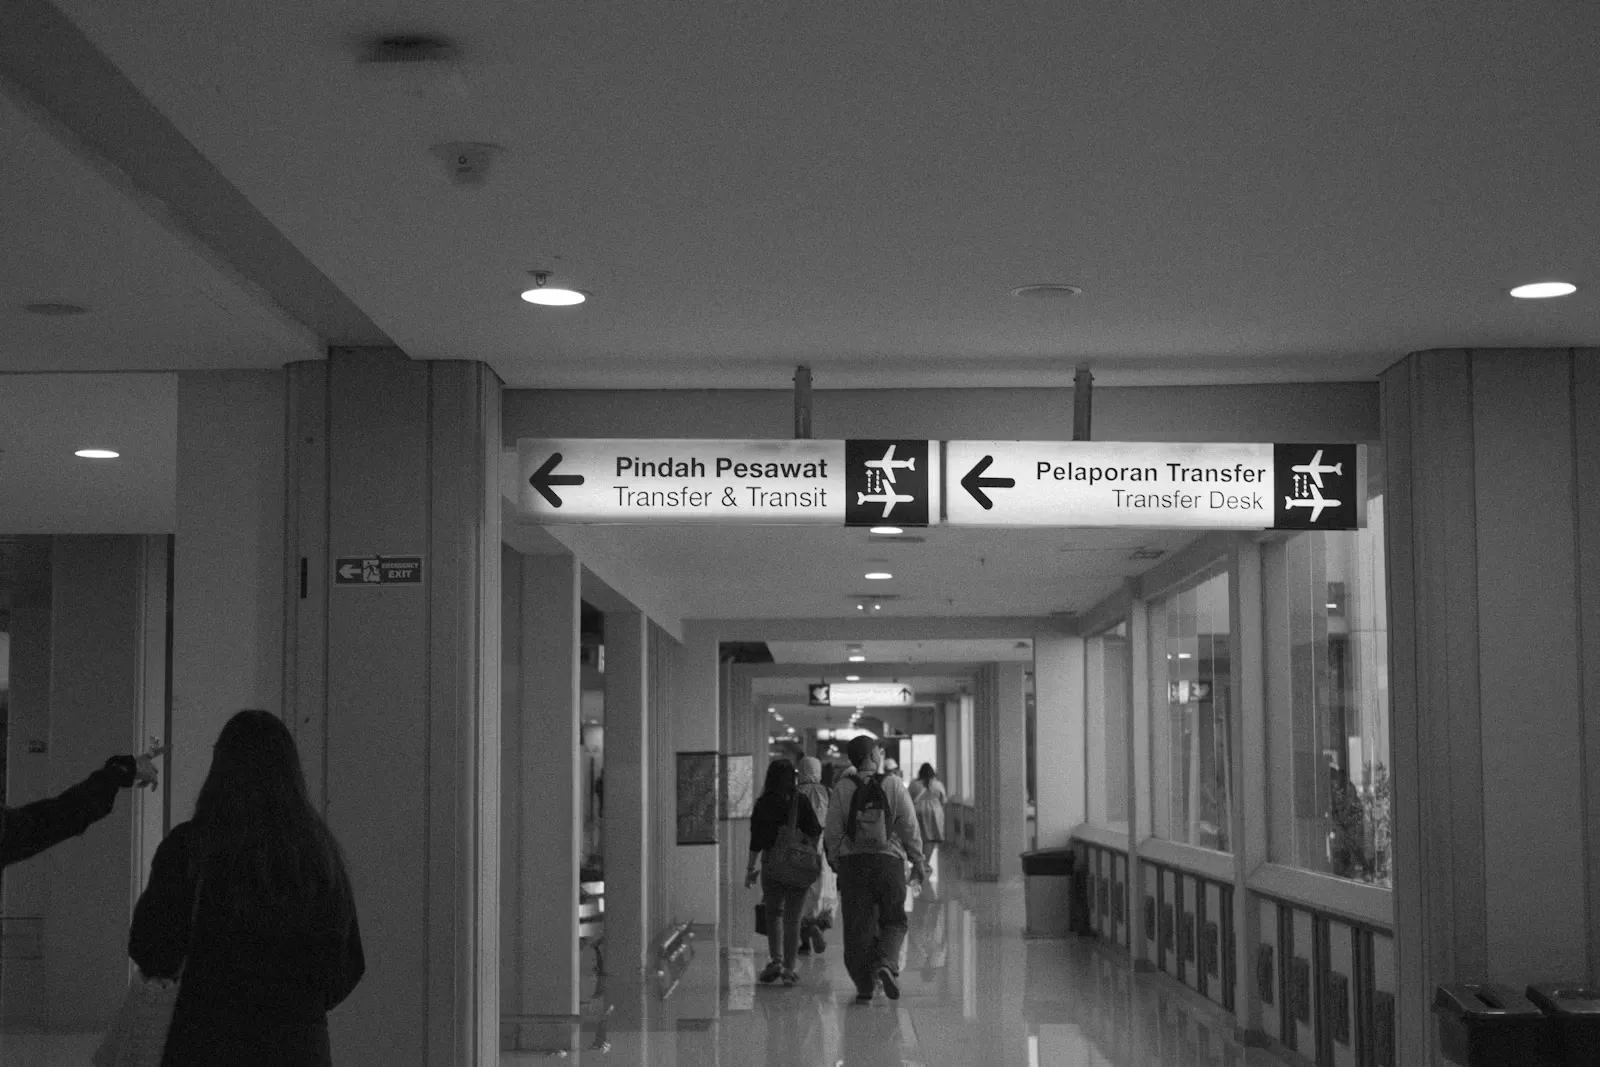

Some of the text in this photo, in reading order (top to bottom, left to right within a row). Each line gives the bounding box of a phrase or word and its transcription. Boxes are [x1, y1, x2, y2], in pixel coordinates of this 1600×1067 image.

[616, 456, 828, 479] Pindah Pesawat
[1036, 461, 1267, 484] Pelaporan Transfer
[612, 485, 828, 508] Transfer & Transit
[1111, 488, 1265, 510] Transfer Desk
[388, 570, 413, 579] EXIT
